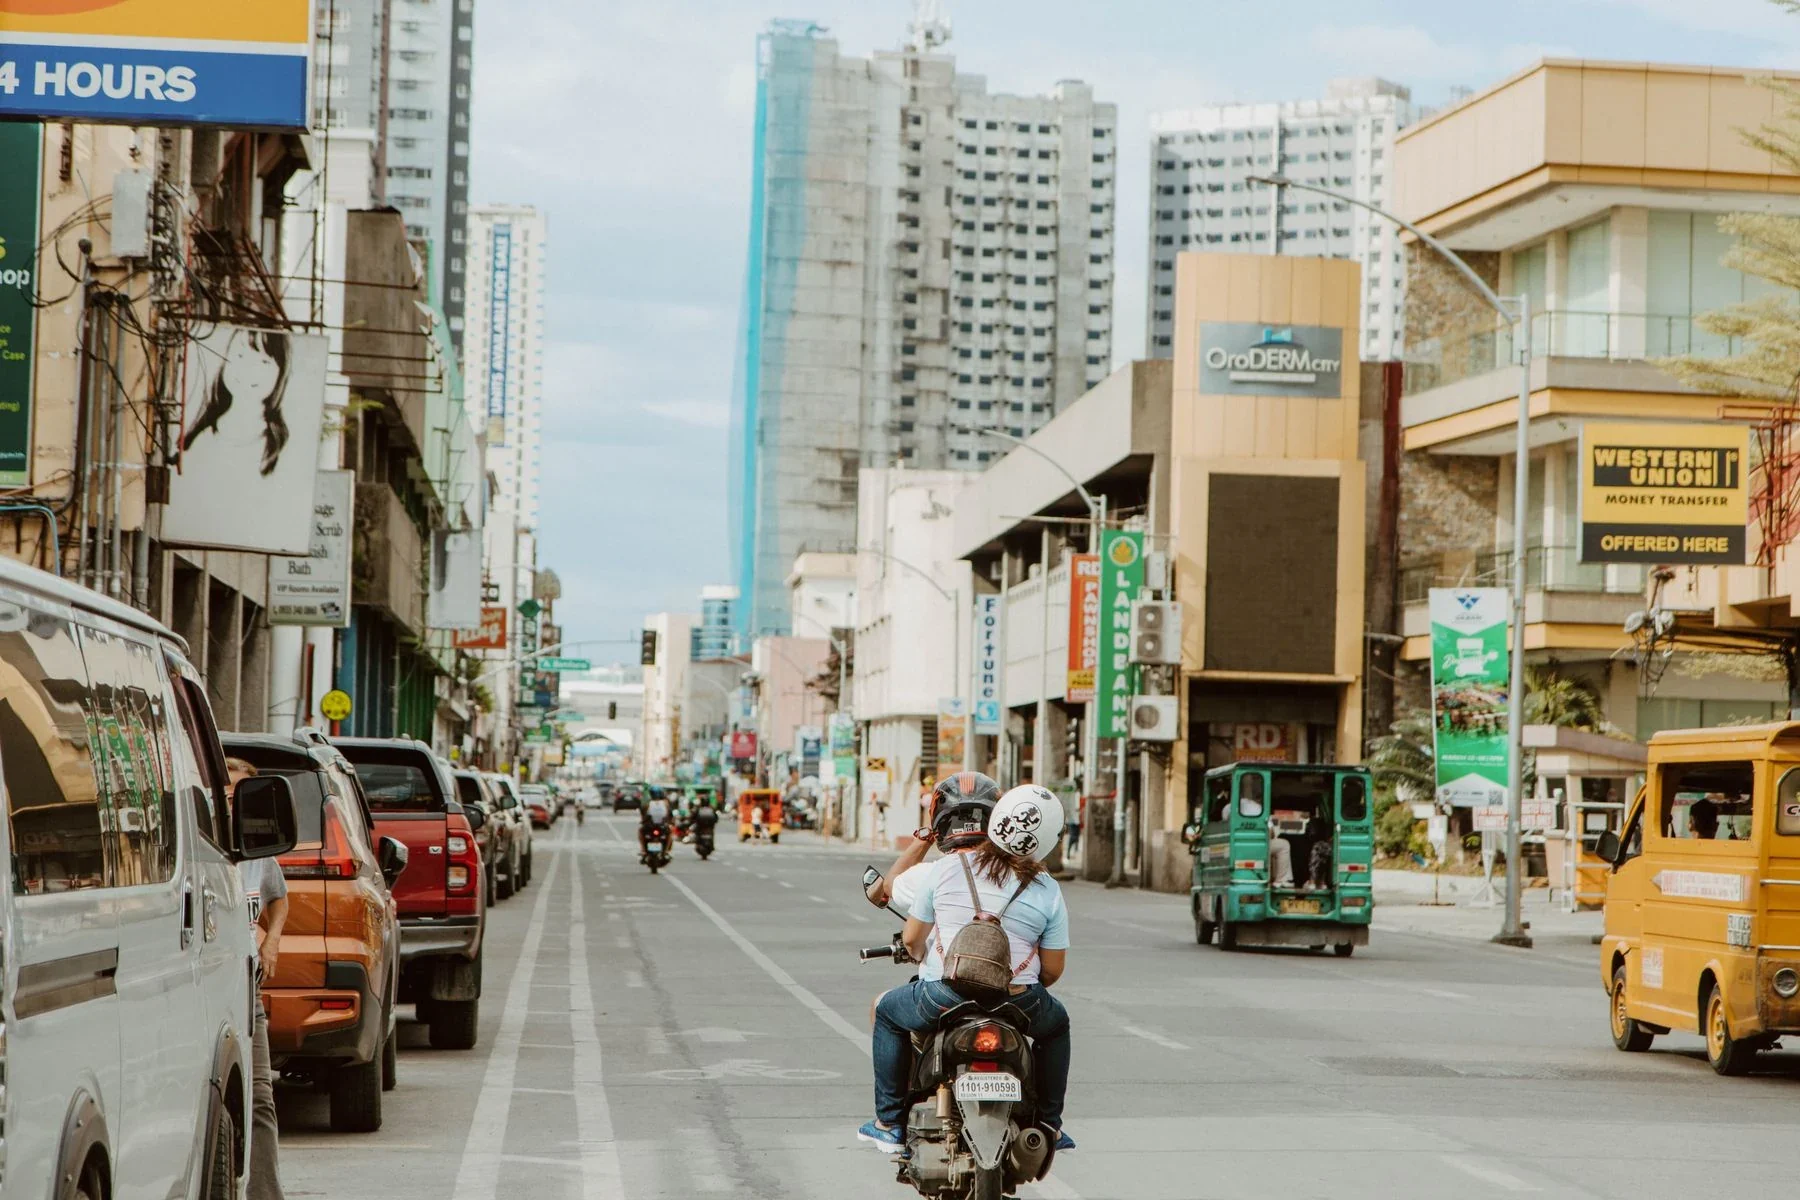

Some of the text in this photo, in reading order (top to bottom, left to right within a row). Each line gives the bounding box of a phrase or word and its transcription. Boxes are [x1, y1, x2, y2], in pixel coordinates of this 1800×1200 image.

[34, 61, 197, 102] HOURS
[494, 235, 508, 268] SALE
[493, 270, 507, 299] FOR
[491, 301, 506, 372] AVAILABLE
[1594, 449, 1712, 468] WESTERN
[1630, 467, 1712, 486] UNION
[1605, 494, 1728, 506] MONEY TRANSFER
[315, 522, 343, 537] Scrub
[1601, 534, 1729, 552] OFFERED HERE
[288, 560, 311, 575] Bath
[1083, 581, 1098, 669] PAWNSHOP
[983, 598, 996, 698] Fortune
[1111, 570, 1131, 732] LANDBANK
[1236, 724, 1281, 749] RD
[960, 1082, 1016, 1093] 1101-910598
